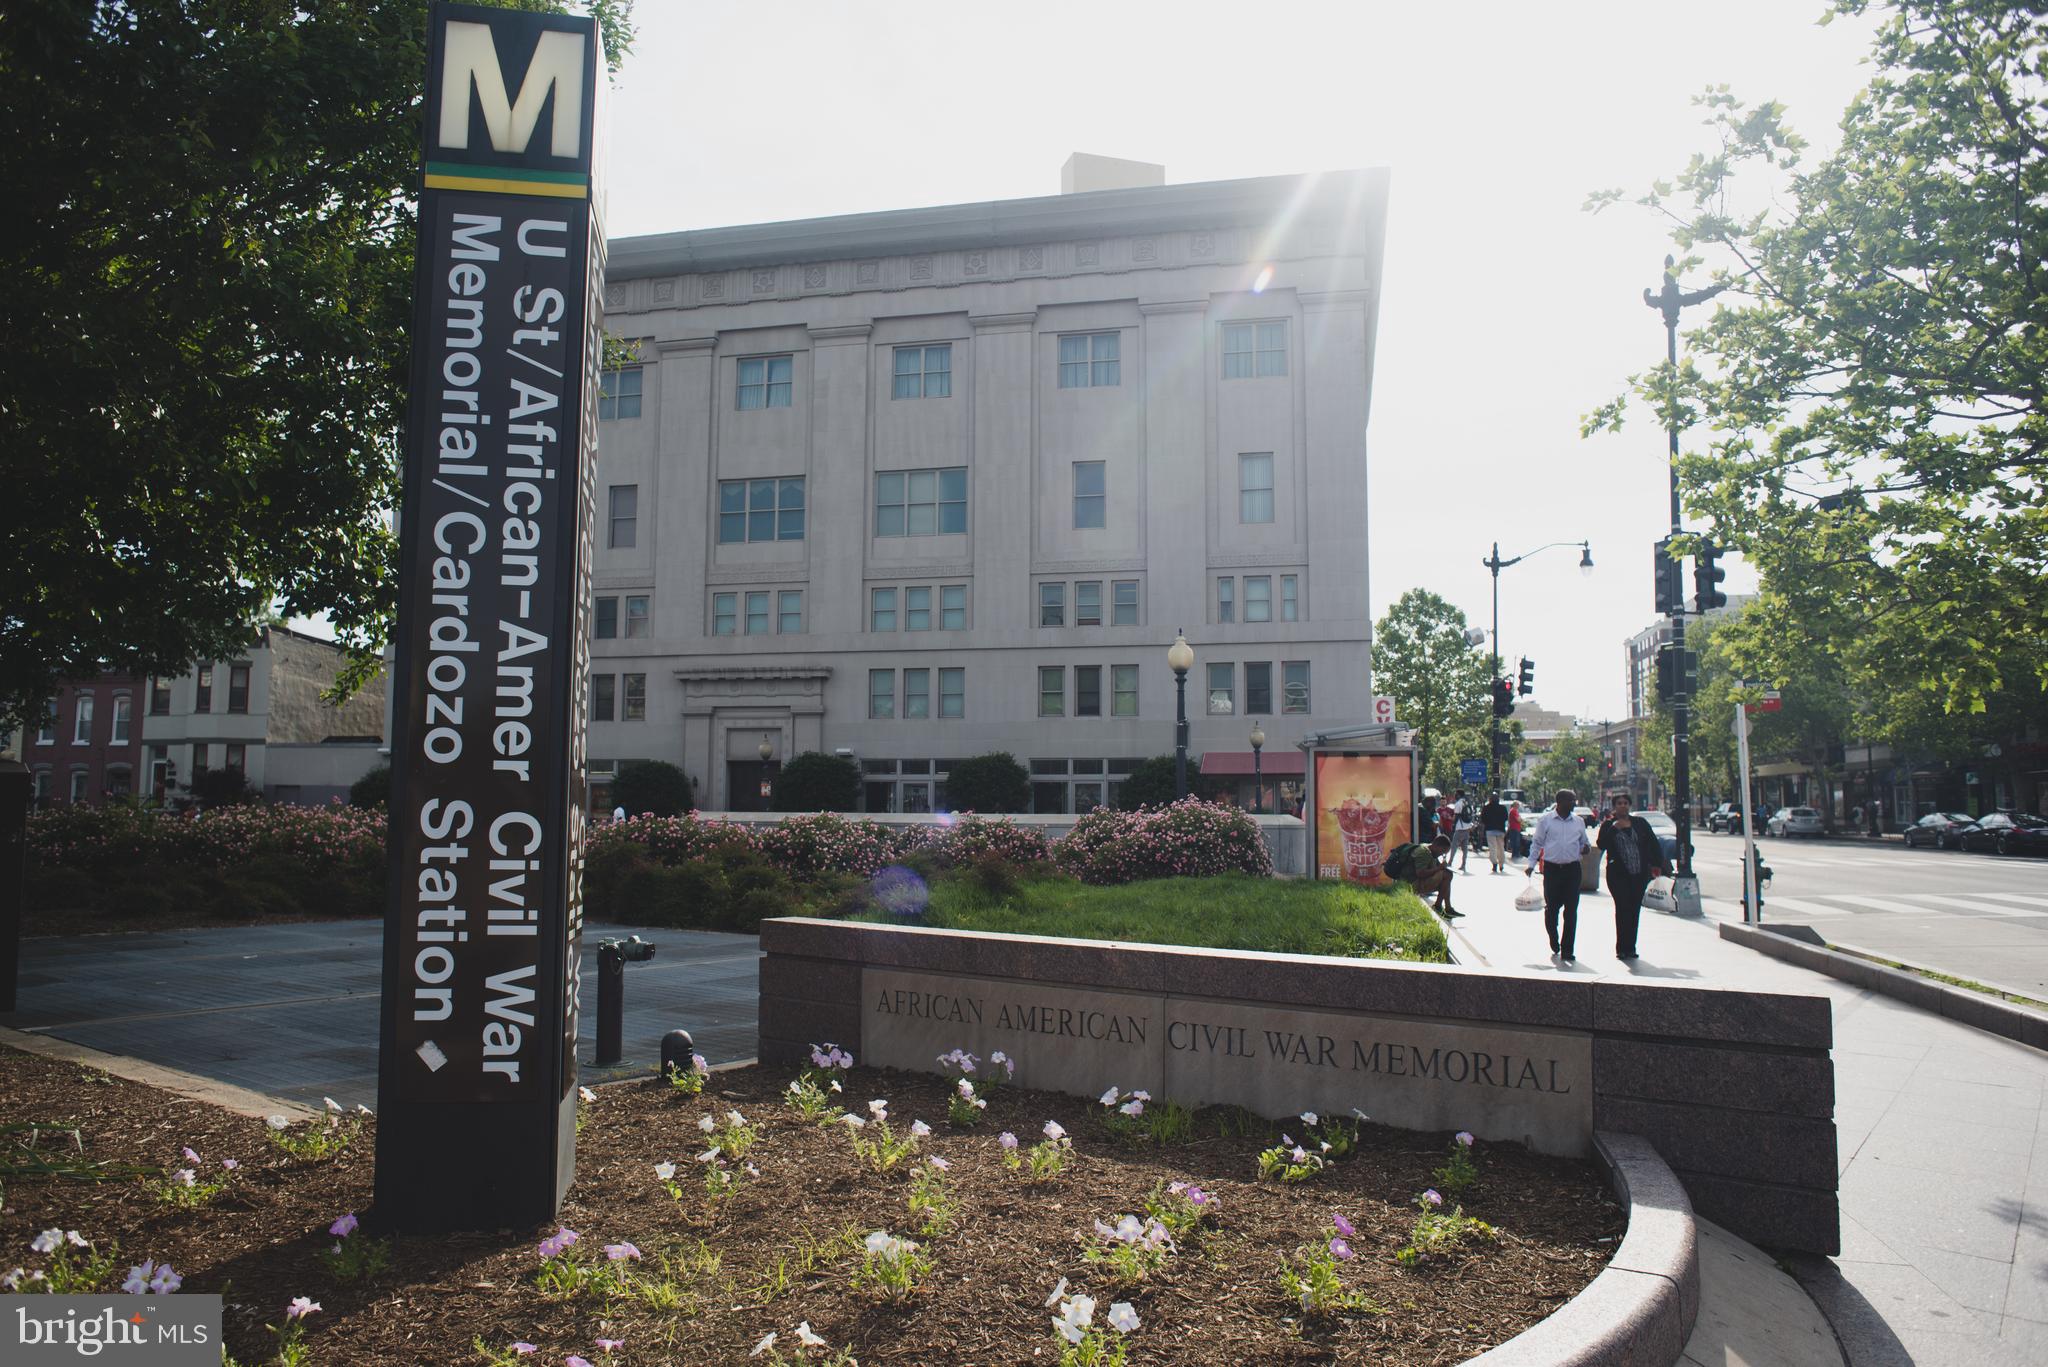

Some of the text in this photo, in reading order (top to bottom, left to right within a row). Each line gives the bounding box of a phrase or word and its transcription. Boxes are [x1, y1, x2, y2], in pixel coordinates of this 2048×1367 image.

[439, 21, 585, 159] M
[414, 213, 501, 1021] Memorial/Cardozo Station
[482, 219, 568, 1083] U St/African-Amer Civil War
[1320, 867, 1341, 877] FREE
[876, 989, 1571, 1094] AFRICAN AMERICAN CIVIL WAR MEMORIAL
